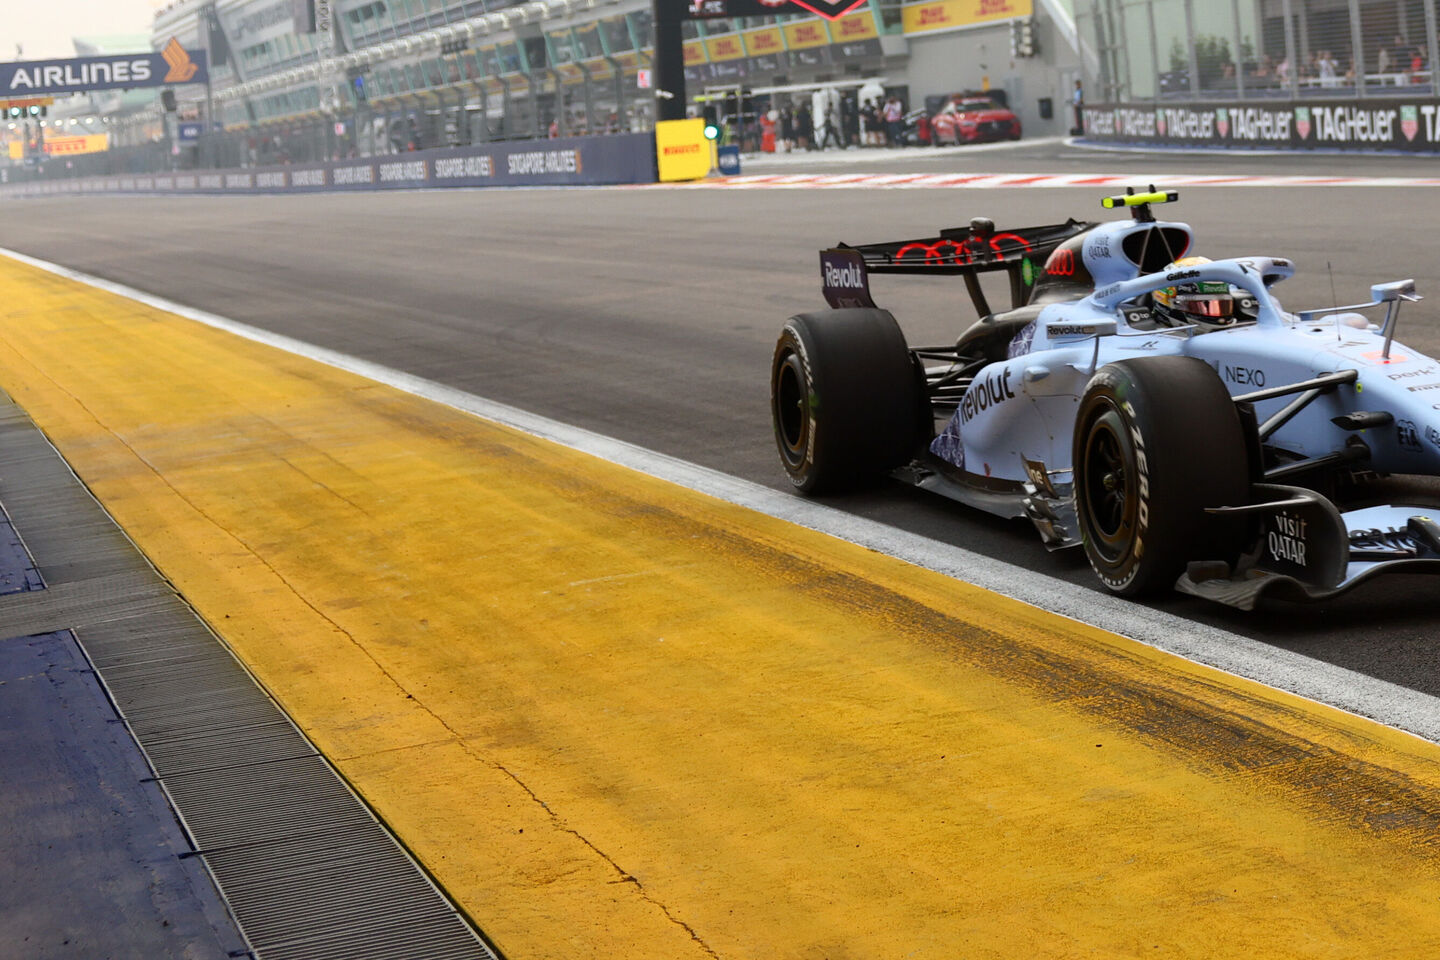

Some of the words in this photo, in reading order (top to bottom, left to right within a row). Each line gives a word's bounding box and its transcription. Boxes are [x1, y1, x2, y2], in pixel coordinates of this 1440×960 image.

[10, 59, 151, 90] AIRLINES
[507, 153, 545, 175] SINGAPORE
[545, 149, 576, 173] AIRLINES
[1089, 245, 1111, 260] QATAR
[825, 261, 864, 289] Revolut
[1166, 269, 1201, 281] Gillette
[1047, 325, 1082, 336] Revolut
[1225, 365, 1266, 388] NEXO
[1130, 424, 1150, 529] ZERO
[1275, 510, 1307, 540] visit
[1269, 531, 1306, 567] QATAR
